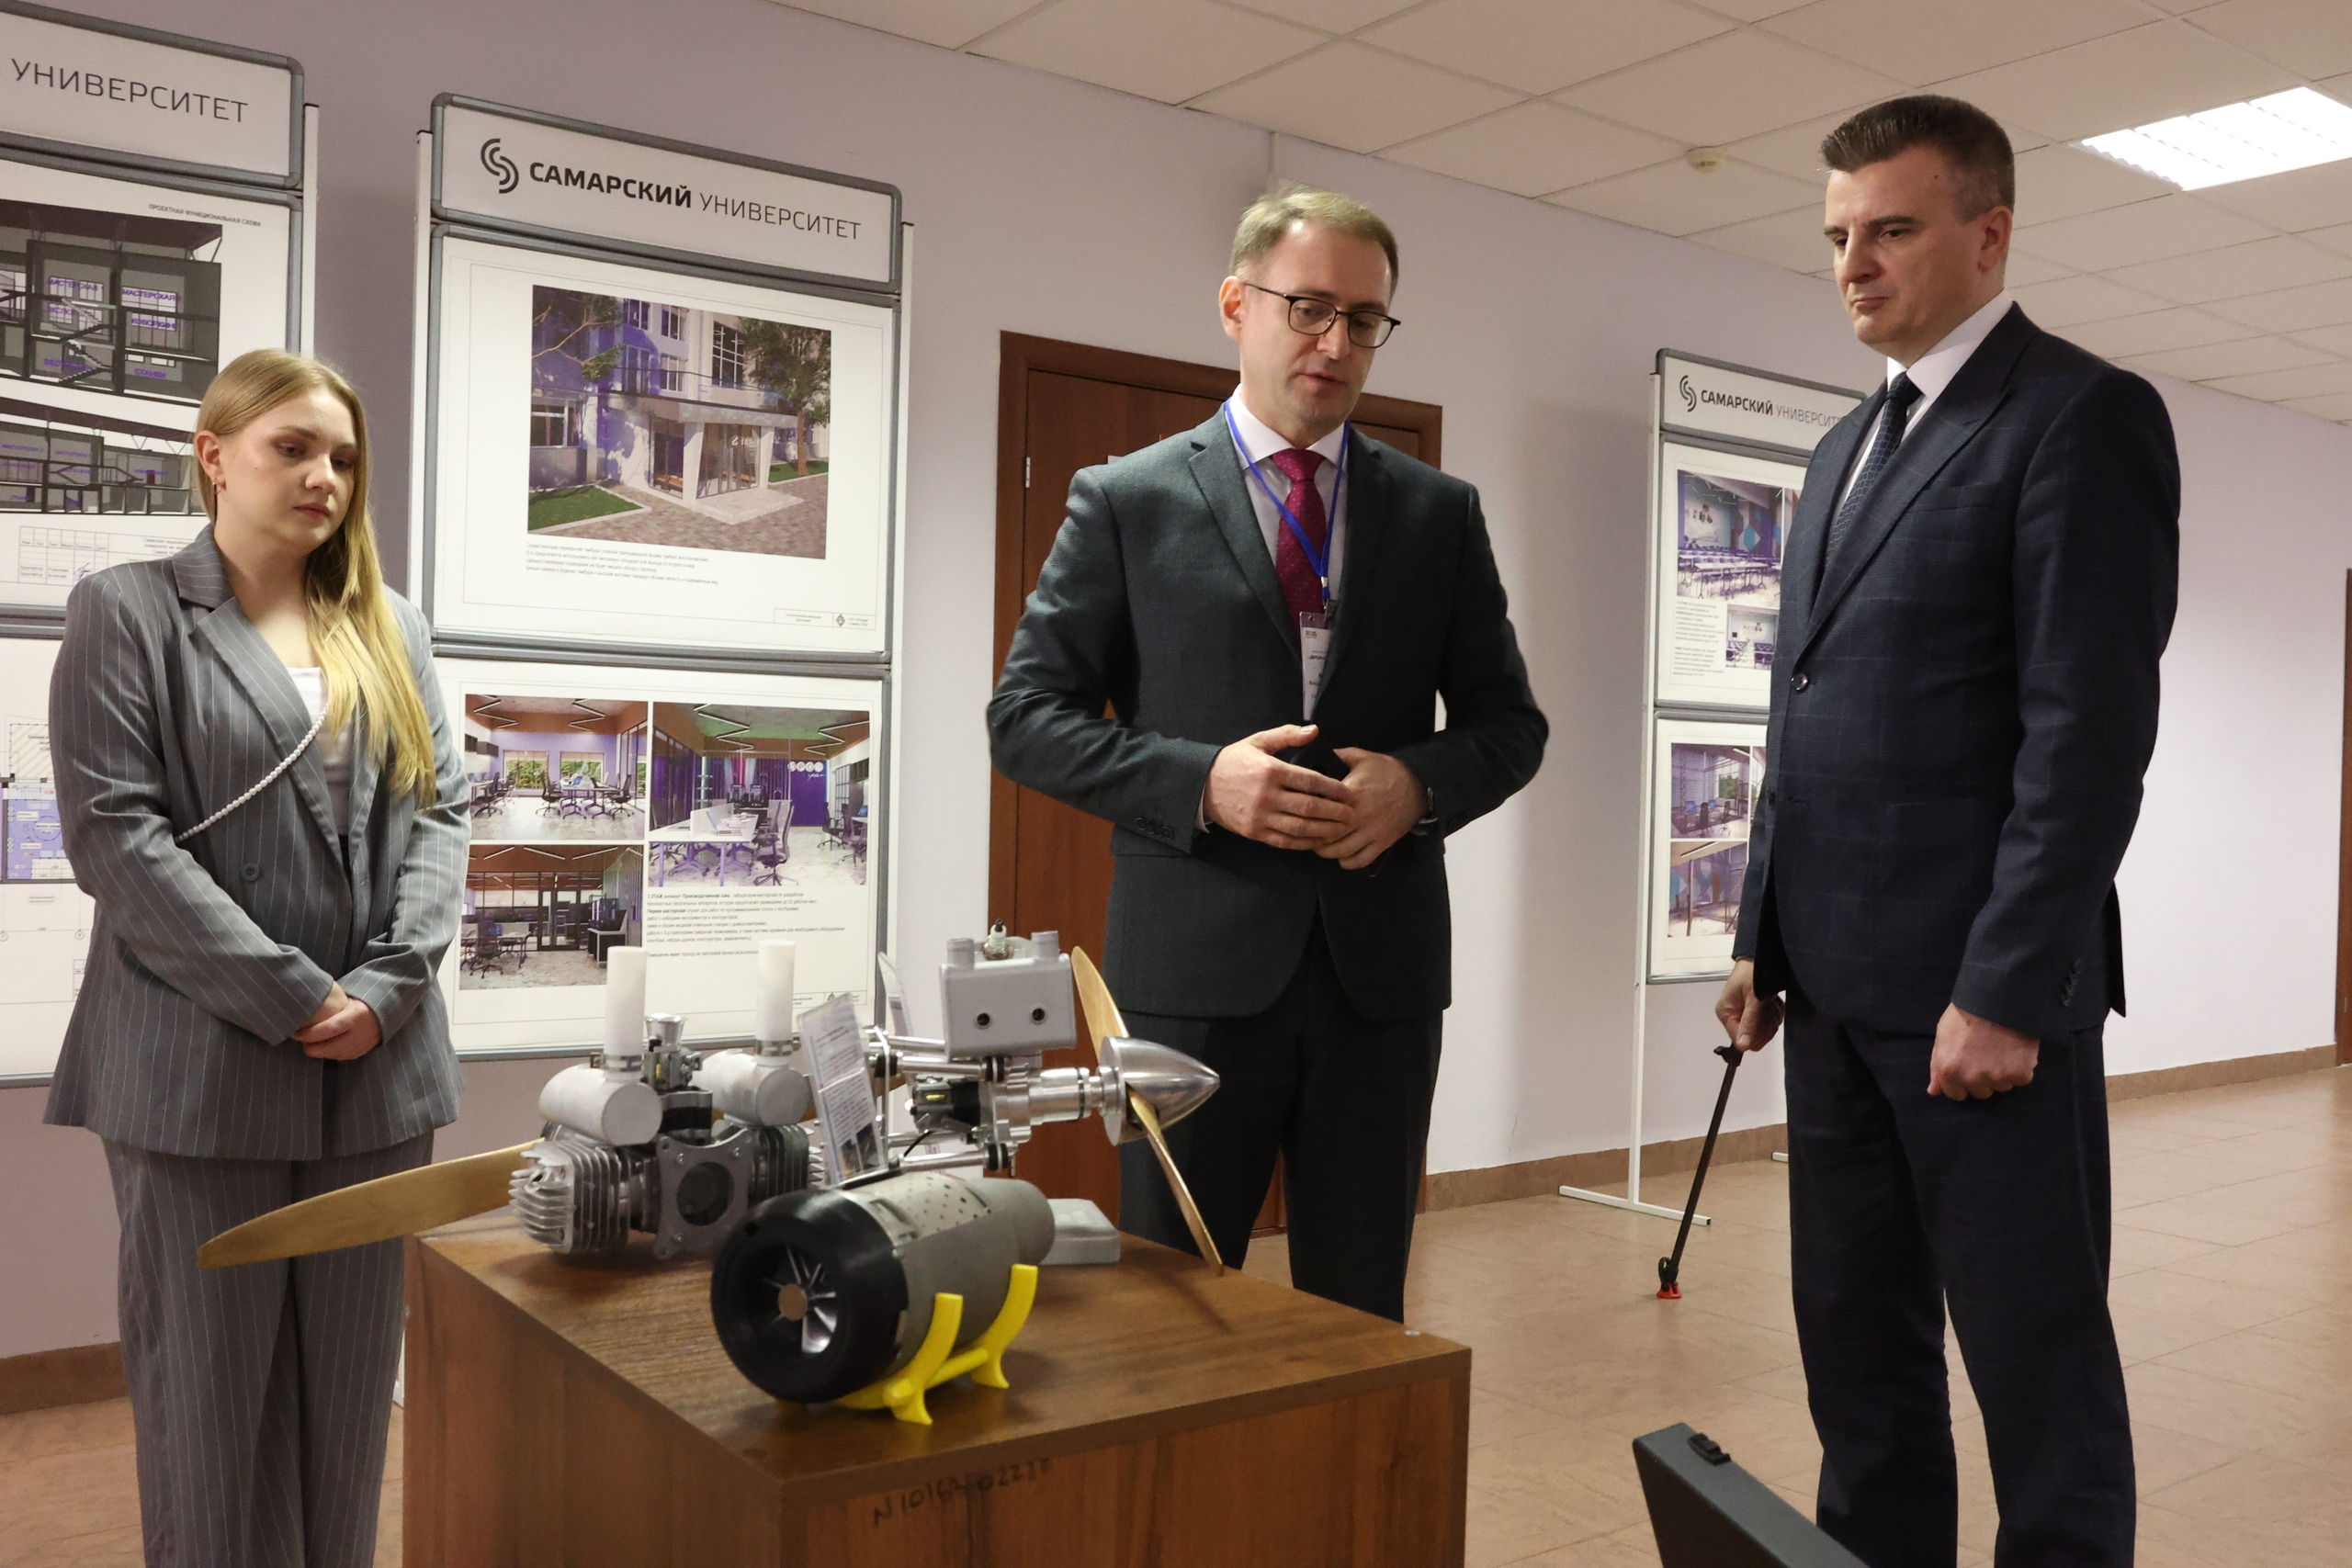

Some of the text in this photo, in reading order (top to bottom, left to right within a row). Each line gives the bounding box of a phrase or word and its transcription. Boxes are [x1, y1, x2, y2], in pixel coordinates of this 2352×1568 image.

[12, 58, 248, 123] УНИВЕРСИТЕТ
[149, 203, 261, 227] ПРОЕКТНАЯ ФУНКЦИОНАЛЬНАЯ СХЕМА
[529, 160, 862, 241] САМАРСКИЙ УНИВЕРСИТЕТ
[122, 289, 175, 301] МАСТЕРСКАЯ
[1701, 389, 1841, 427] САМАРСКИЙ УНИВЕРСИТ
